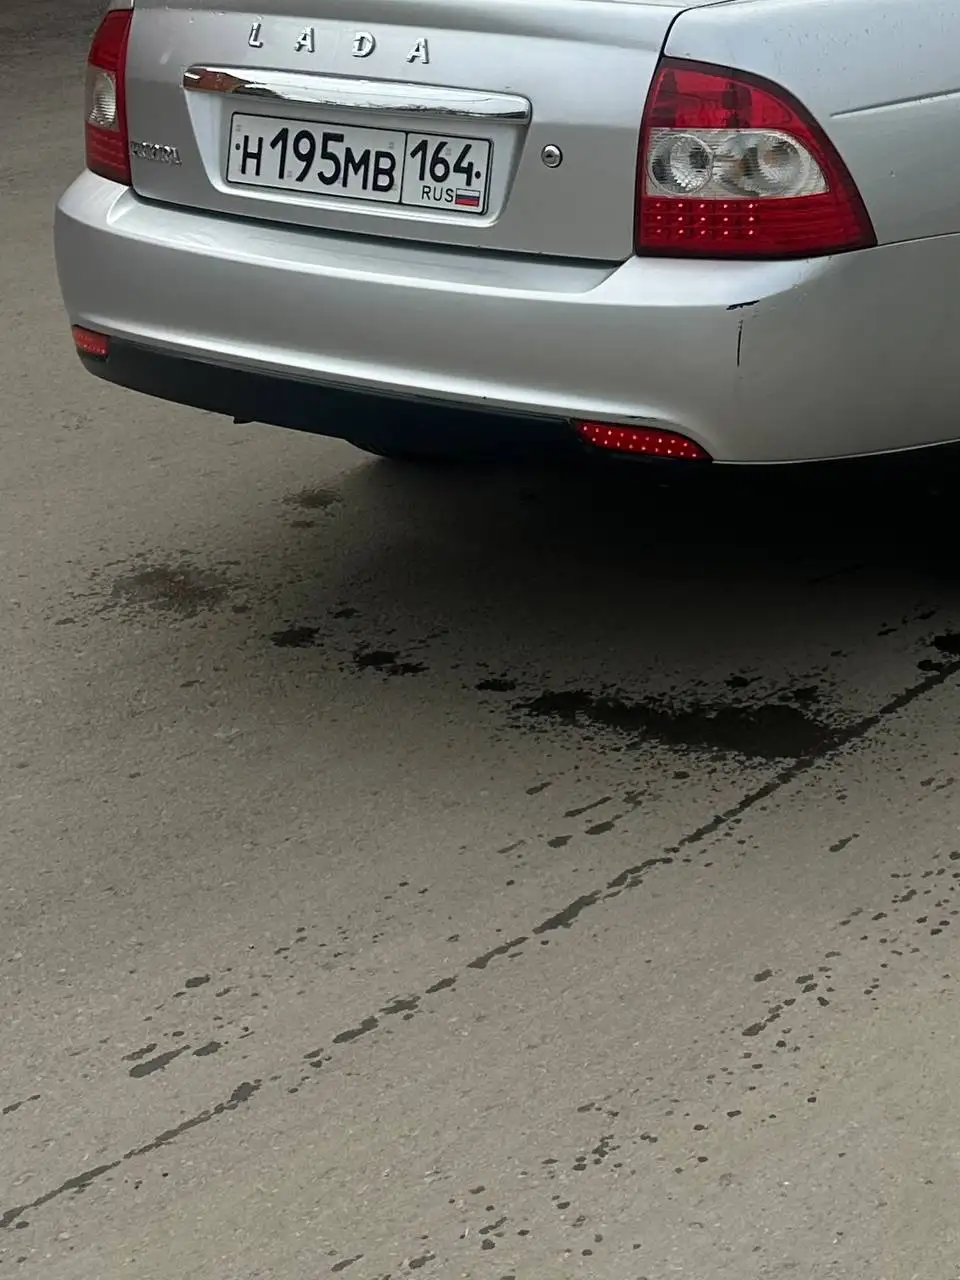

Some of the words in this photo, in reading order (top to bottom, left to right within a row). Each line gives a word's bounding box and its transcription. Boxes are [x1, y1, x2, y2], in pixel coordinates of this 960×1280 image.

[248, 21, 430, 65] LADA
[409, 138, 475, 187] 164
[421, 185, 454, 203] RUS
